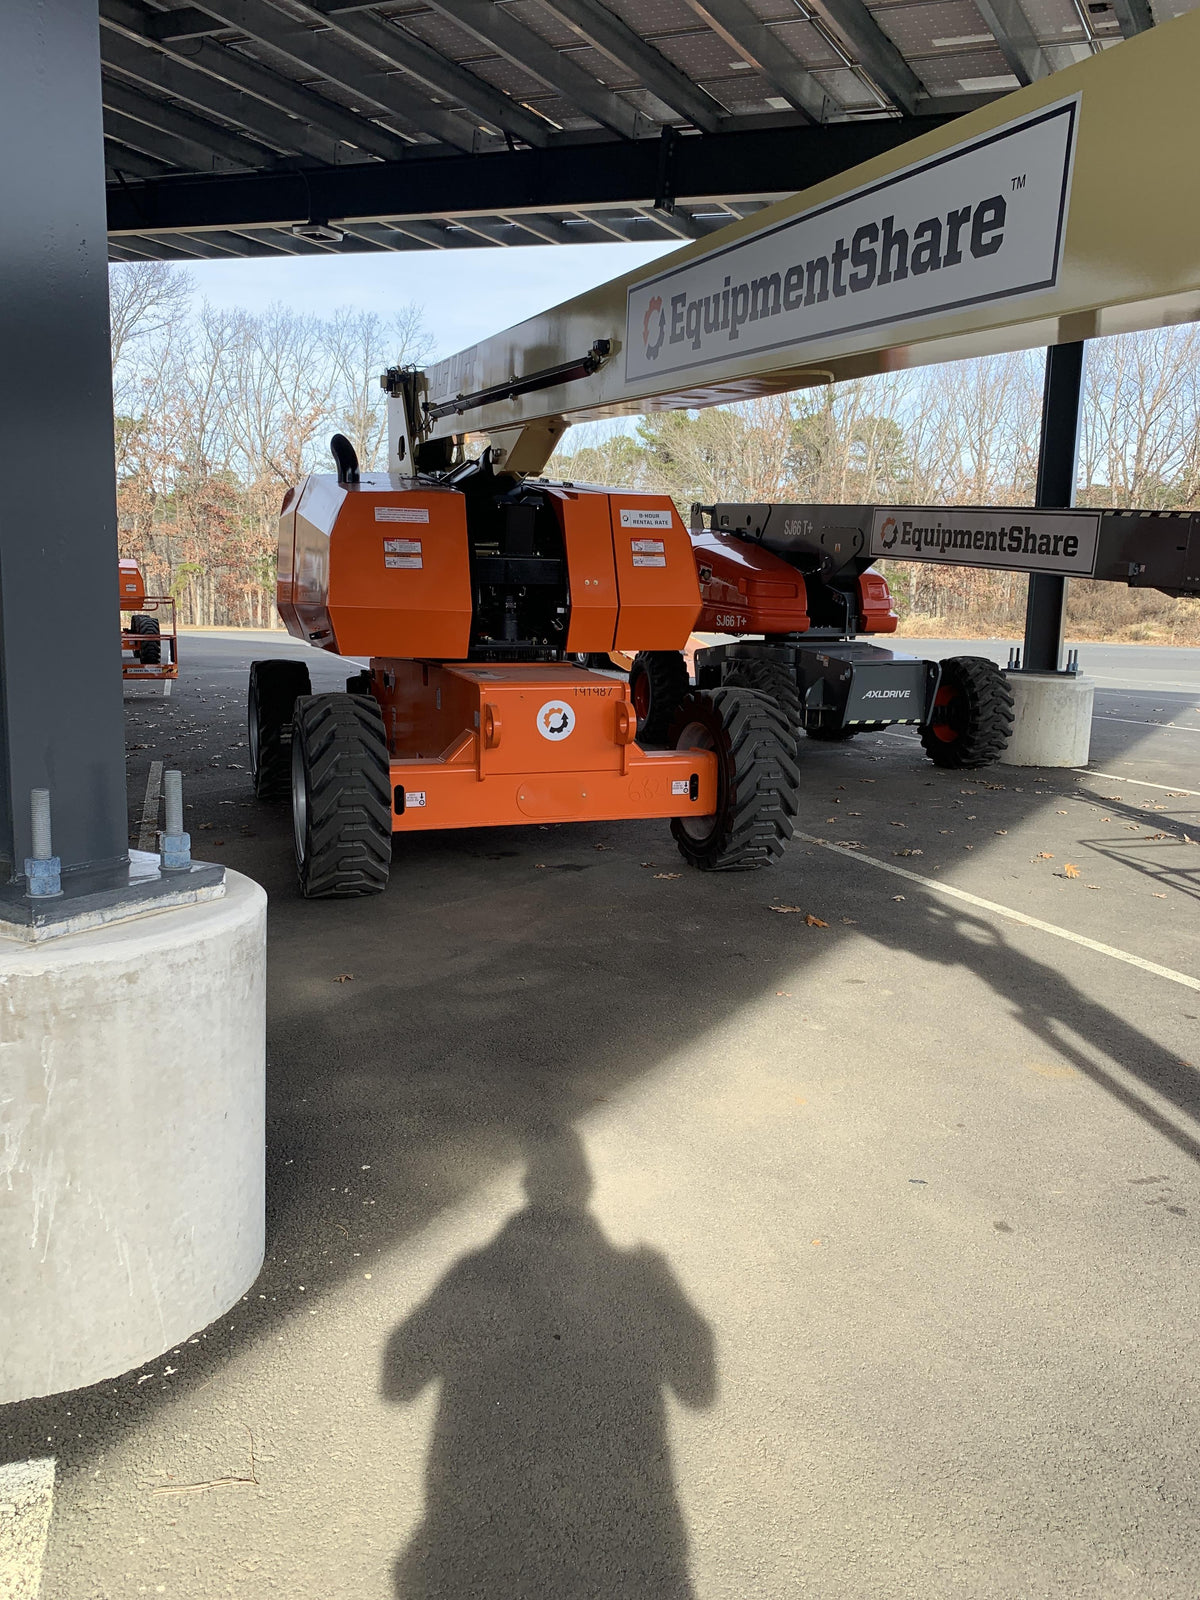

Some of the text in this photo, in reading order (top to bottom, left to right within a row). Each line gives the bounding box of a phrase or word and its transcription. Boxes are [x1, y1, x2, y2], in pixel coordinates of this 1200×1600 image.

[669, 194, 1007, 350] EquipmentShare
[784, 520, 813, 536] SJ66 T+
[900, 521, 1079, 557] EquipmentShare
[716, 615, 747, 627] SJ66 T+
[862, 690, 911, 699] AXLDRIVE
